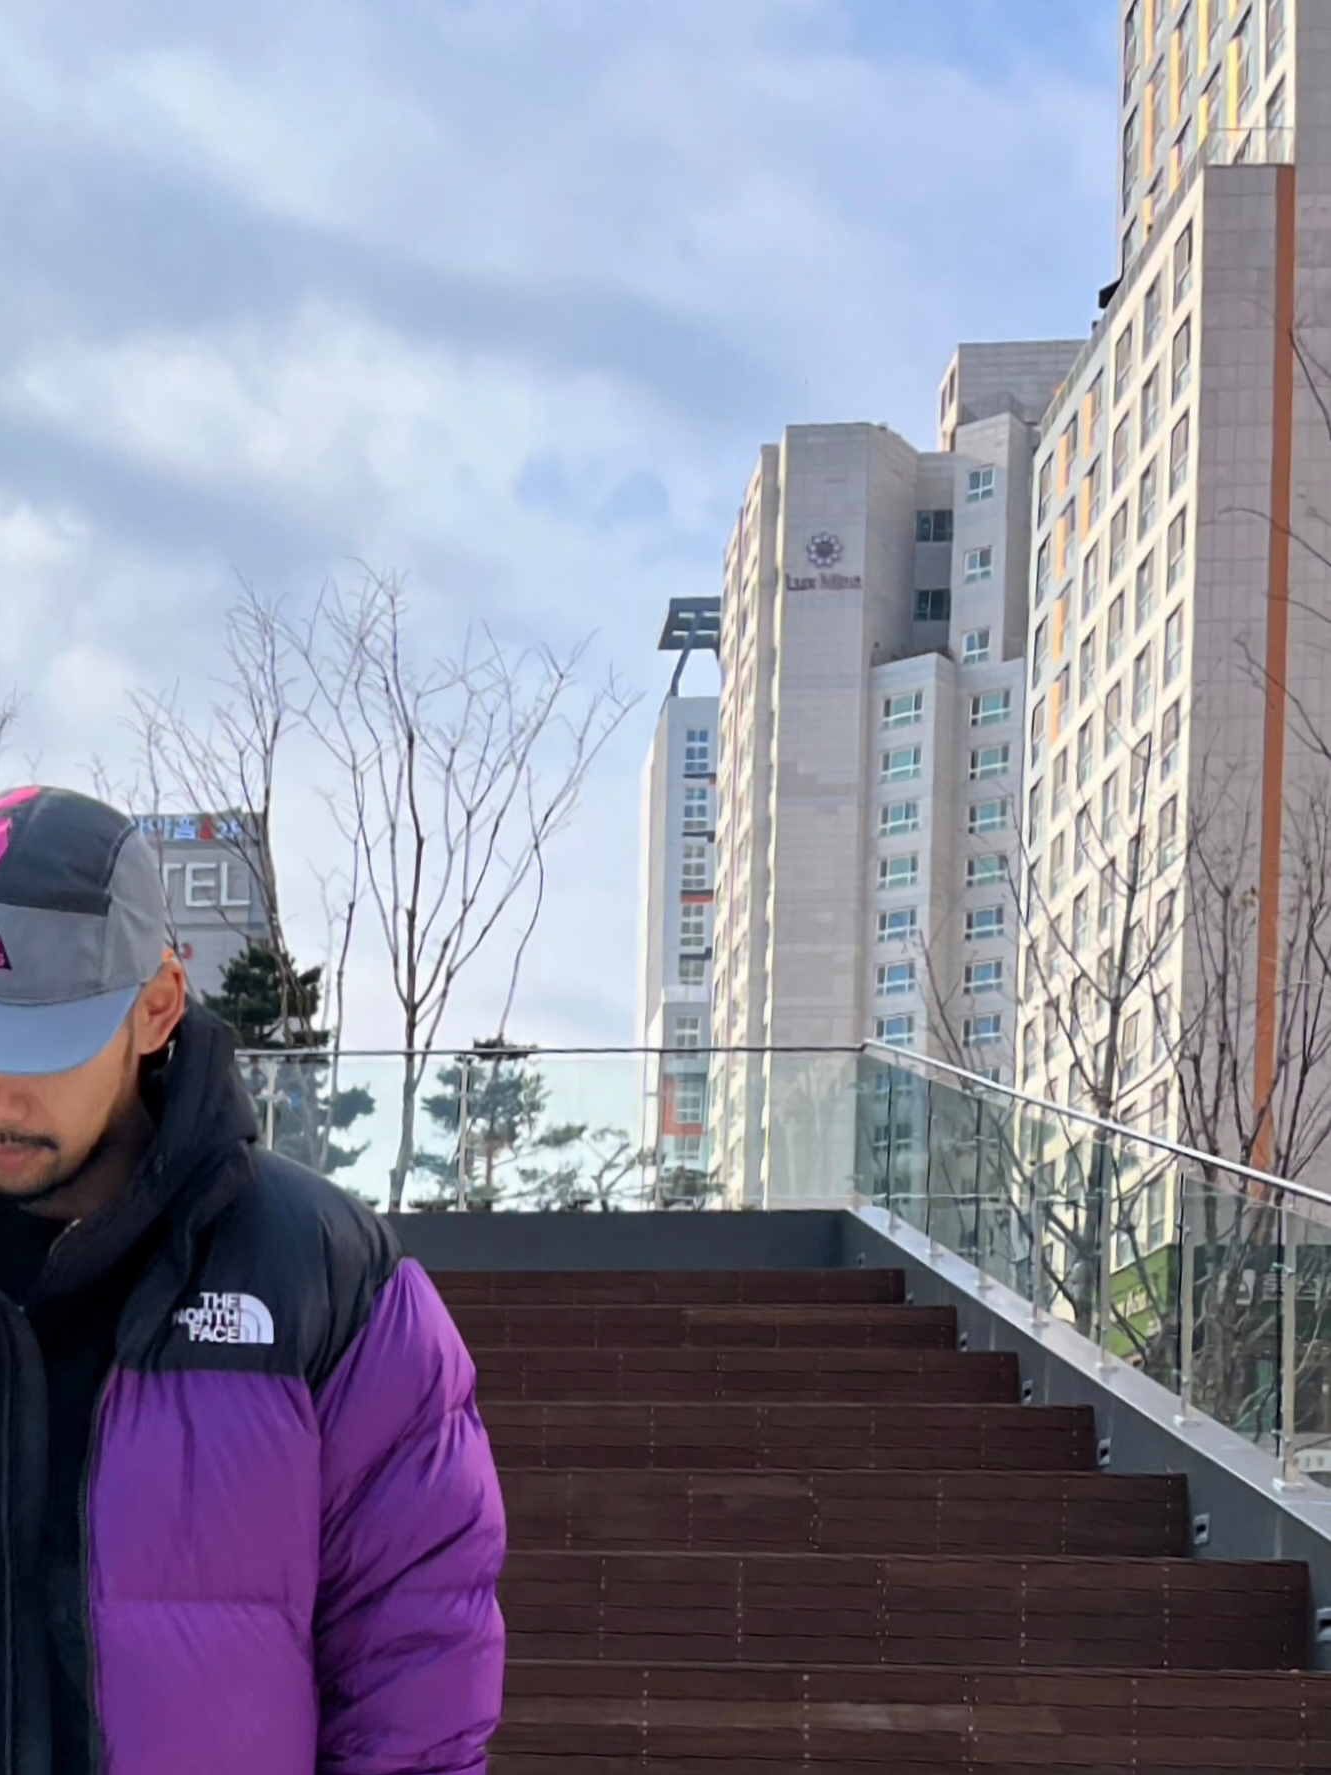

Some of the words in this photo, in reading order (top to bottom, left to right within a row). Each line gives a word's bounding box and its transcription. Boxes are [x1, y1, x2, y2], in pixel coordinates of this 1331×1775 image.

[163, 862, 251, 907] TEL
[199, 1292, 240, 1309] THE
[173, 1307, 240, 1327] NORTH
[188, 1325, 240, 1343] FACE
